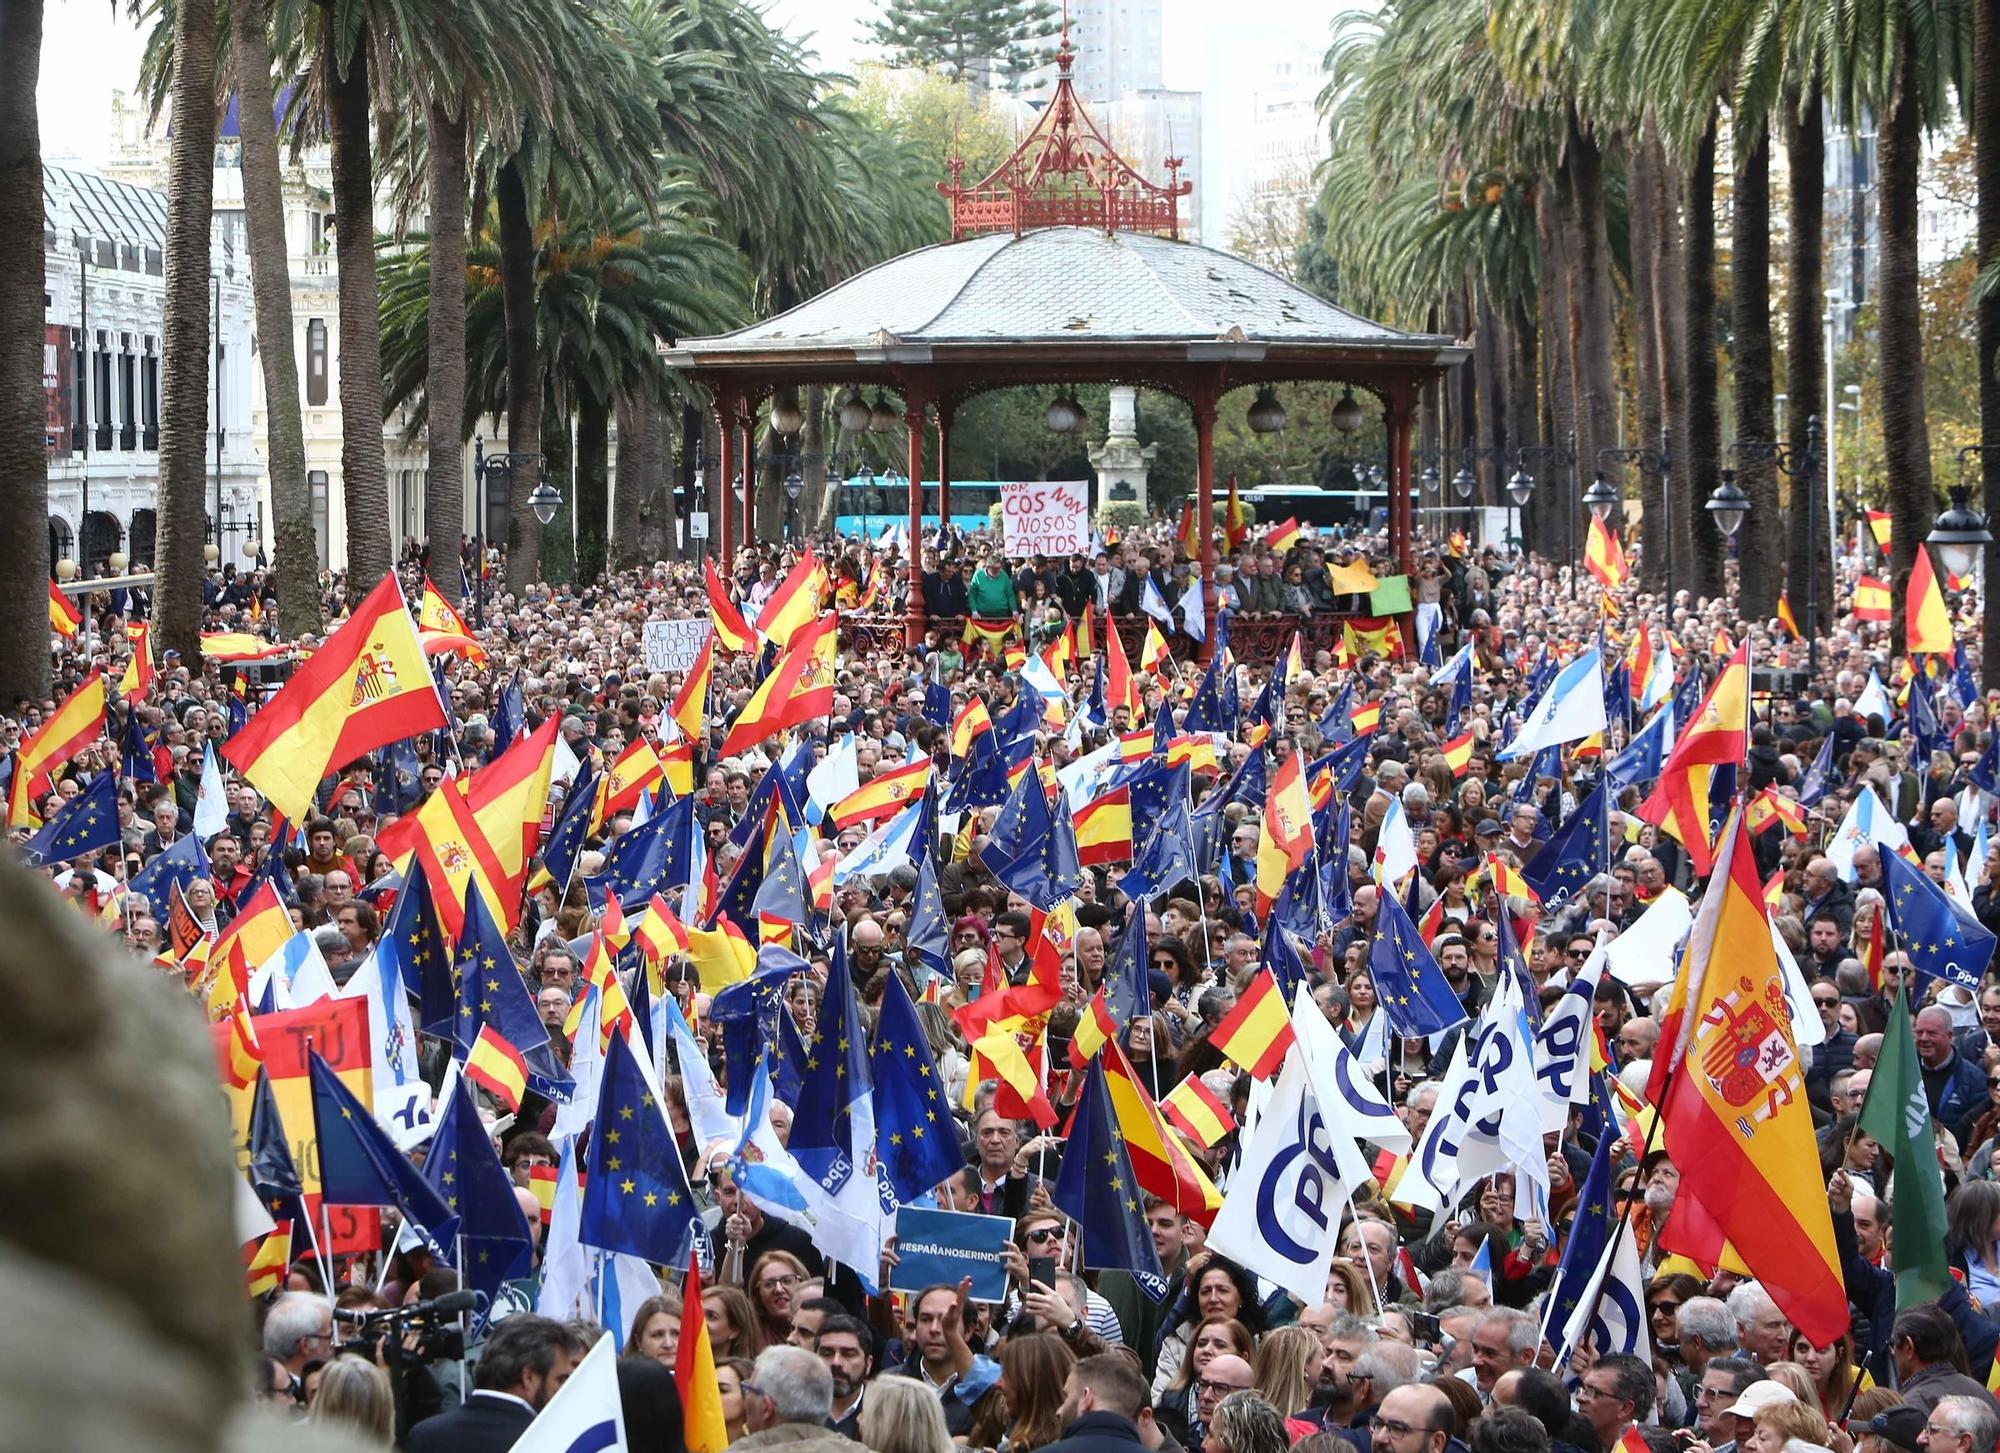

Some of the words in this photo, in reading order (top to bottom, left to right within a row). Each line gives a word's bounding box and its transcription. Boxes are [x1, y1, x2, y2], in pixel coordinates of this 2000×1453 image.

[1005, 492, 1046, 516] COS
[1051, 486, 1088, 514] NON
[1017, 513, 1077, 534] NOSOS
[1005, 535, 1077, 555] CARTOS
[647, 624, 669, 641] WE
[668, 621, 708, 639] MUST
[648, 637, 685, 655] STOP
[286, 1011, 347, 1071] TÚ
[899, 1241, 1001, 1264] #ESPAÑANOSERINDE
